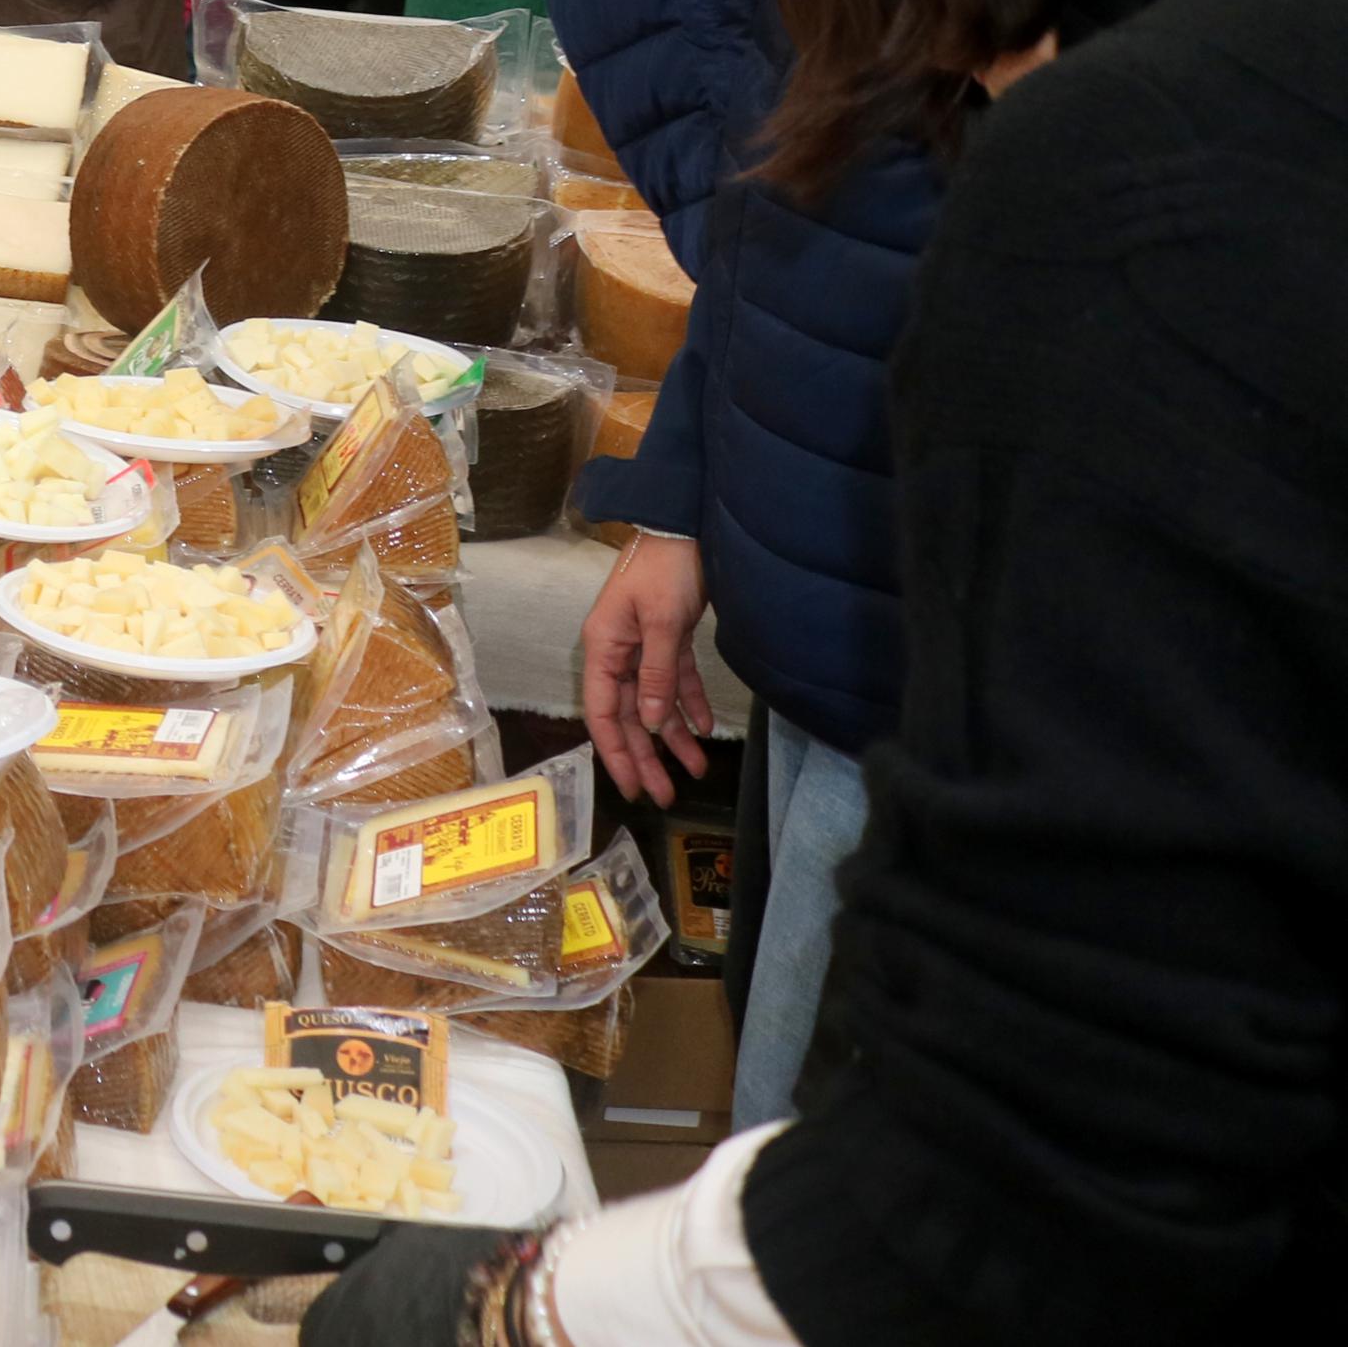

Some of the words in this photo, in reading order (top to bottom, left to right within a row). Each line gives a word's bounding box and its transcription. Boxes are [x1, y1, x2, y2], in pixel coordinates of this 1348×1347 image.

[272, 573, 304, 606] CERRATO
[510, 813, 523, 852] CERRATO
[572, 902, 596, 938] CERRATO
[297, 1012, 352, 1027] QUESO
